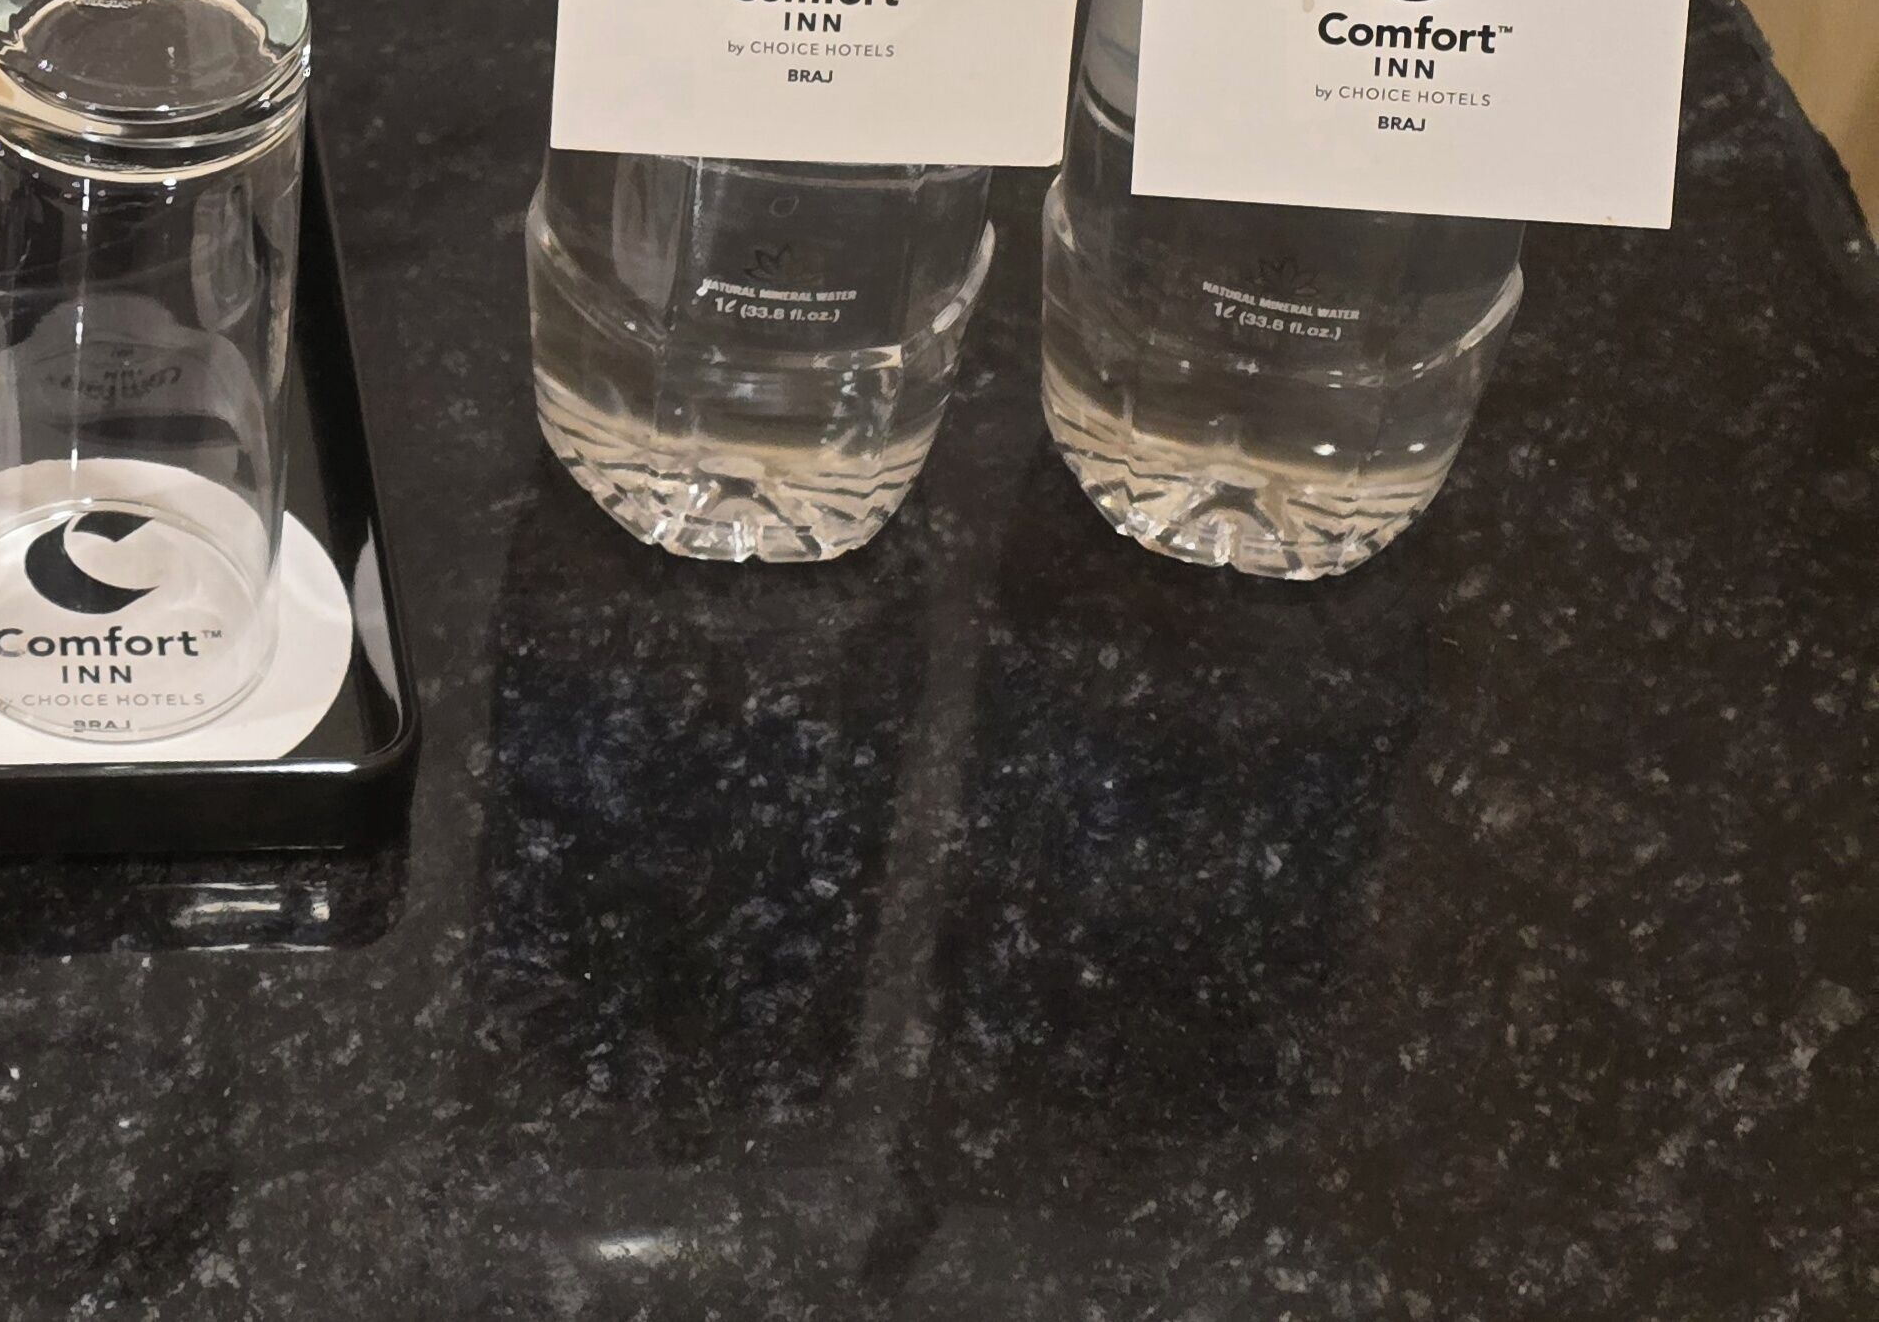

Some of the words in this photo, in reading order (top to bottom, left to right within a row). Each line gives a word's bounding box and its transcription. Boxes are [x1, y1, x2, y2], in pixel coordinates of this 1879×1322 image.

[784, 12, 841, 32] INN
[727, 40, 744, 56] by
[750, 41, 819, 55] CHOICE
[825, 43, 894, 57] HOTELS
[787, 69, 833, 83] BRAJ
[1374, 57, 1435, 79] INN
[1315, 84, 1332, 101] by
[1339, 86, 1411, 102] CHOICE
[1418, 91, 1491, 106] HOTELS
[1378, 116, 1426, 131] BRAJ
[816, 290, 858, 302] WATER
[1202, 281, 1256, 306] NATURAL
[1317, 308, 1360, 320] WATER
[1239, 311, 1284, 331] (33.8
[62, 665, 132, 684] INN
[21, 693, 109, 707] CHOICE
[117, 693, 206, 706] HOTELS
